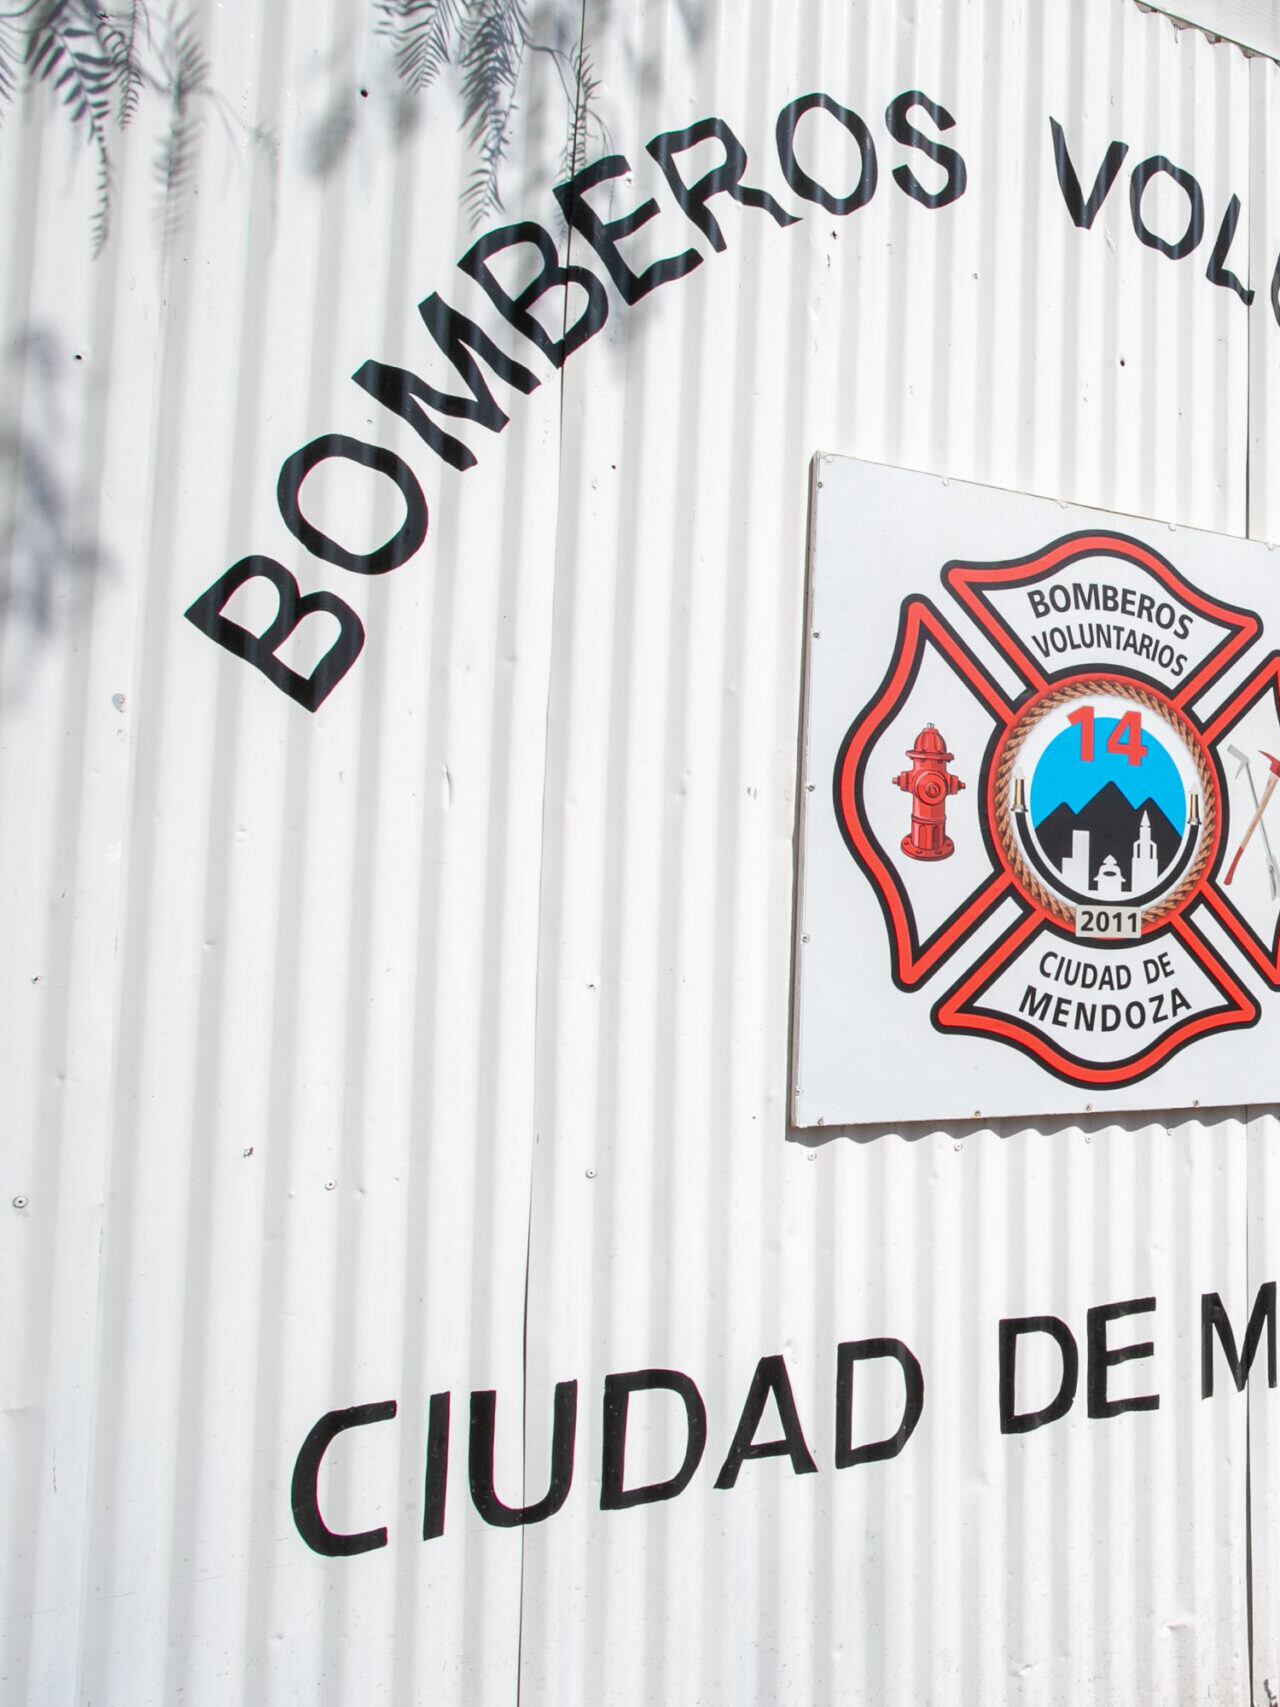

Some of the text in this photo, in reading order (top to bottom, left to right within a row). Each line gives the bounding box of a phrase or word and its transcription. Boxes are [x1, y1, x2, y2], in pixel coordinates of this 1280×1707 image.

[186, 90, 968, 713] BOMBEROS
[1027, 582, 1194, 640] BOMBEROS
[1031, 623, 1188, 677] VOLUNTARIOS
[1067, 705, 1149, 767] 14
[1080, 910, 1138, 933] 2011
[1039, 951, 1175, 991] CIUDAD DE
[1018, 985, 1193, 1033] MENDOZA
[292, 1338, 924, 1558] CIUDAD
[999, 1297, 1160, 1434] DE
